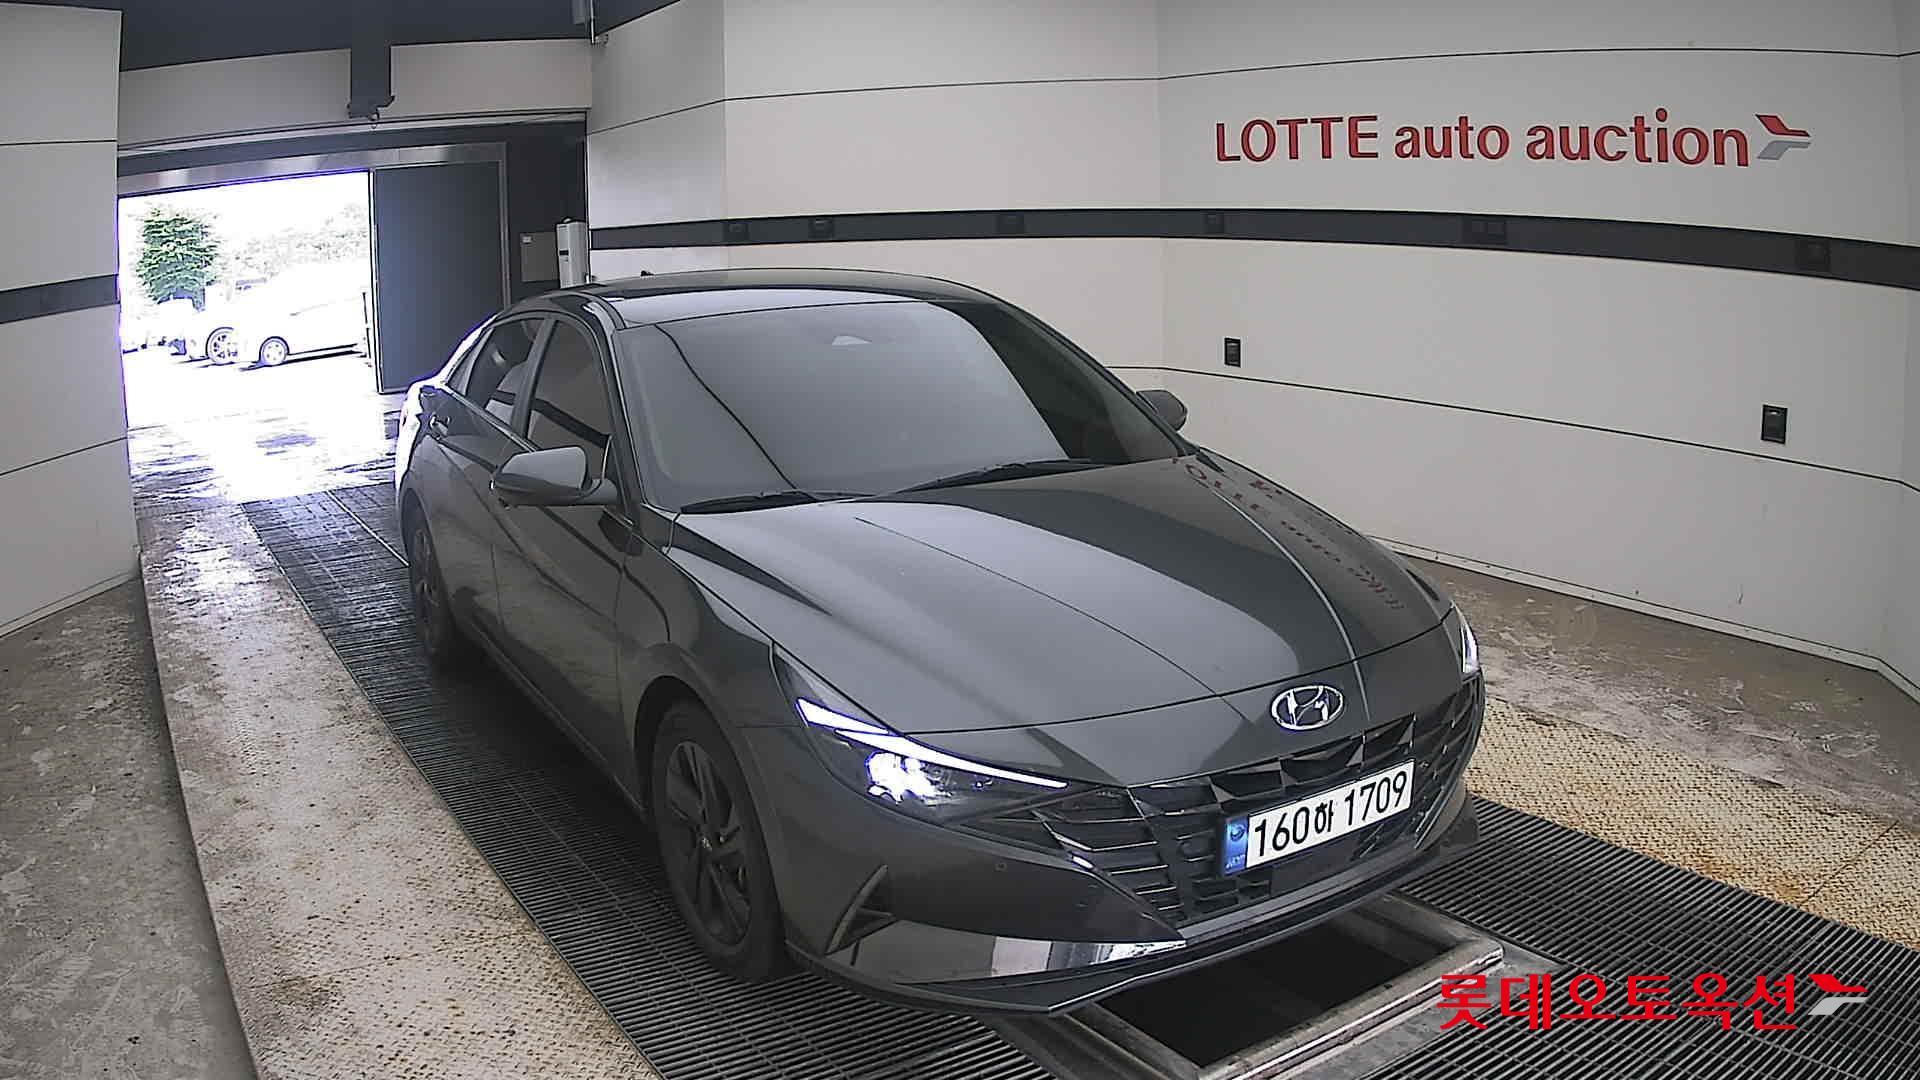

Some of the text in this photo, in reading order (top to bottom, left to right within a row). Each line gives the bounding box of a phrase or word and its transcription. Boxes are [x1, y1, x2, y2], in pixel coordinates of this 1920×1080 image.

[1216, 108, 1750, 167] LOTTE auto auction
[1254, 771, 1408, 857] 160하 1709
